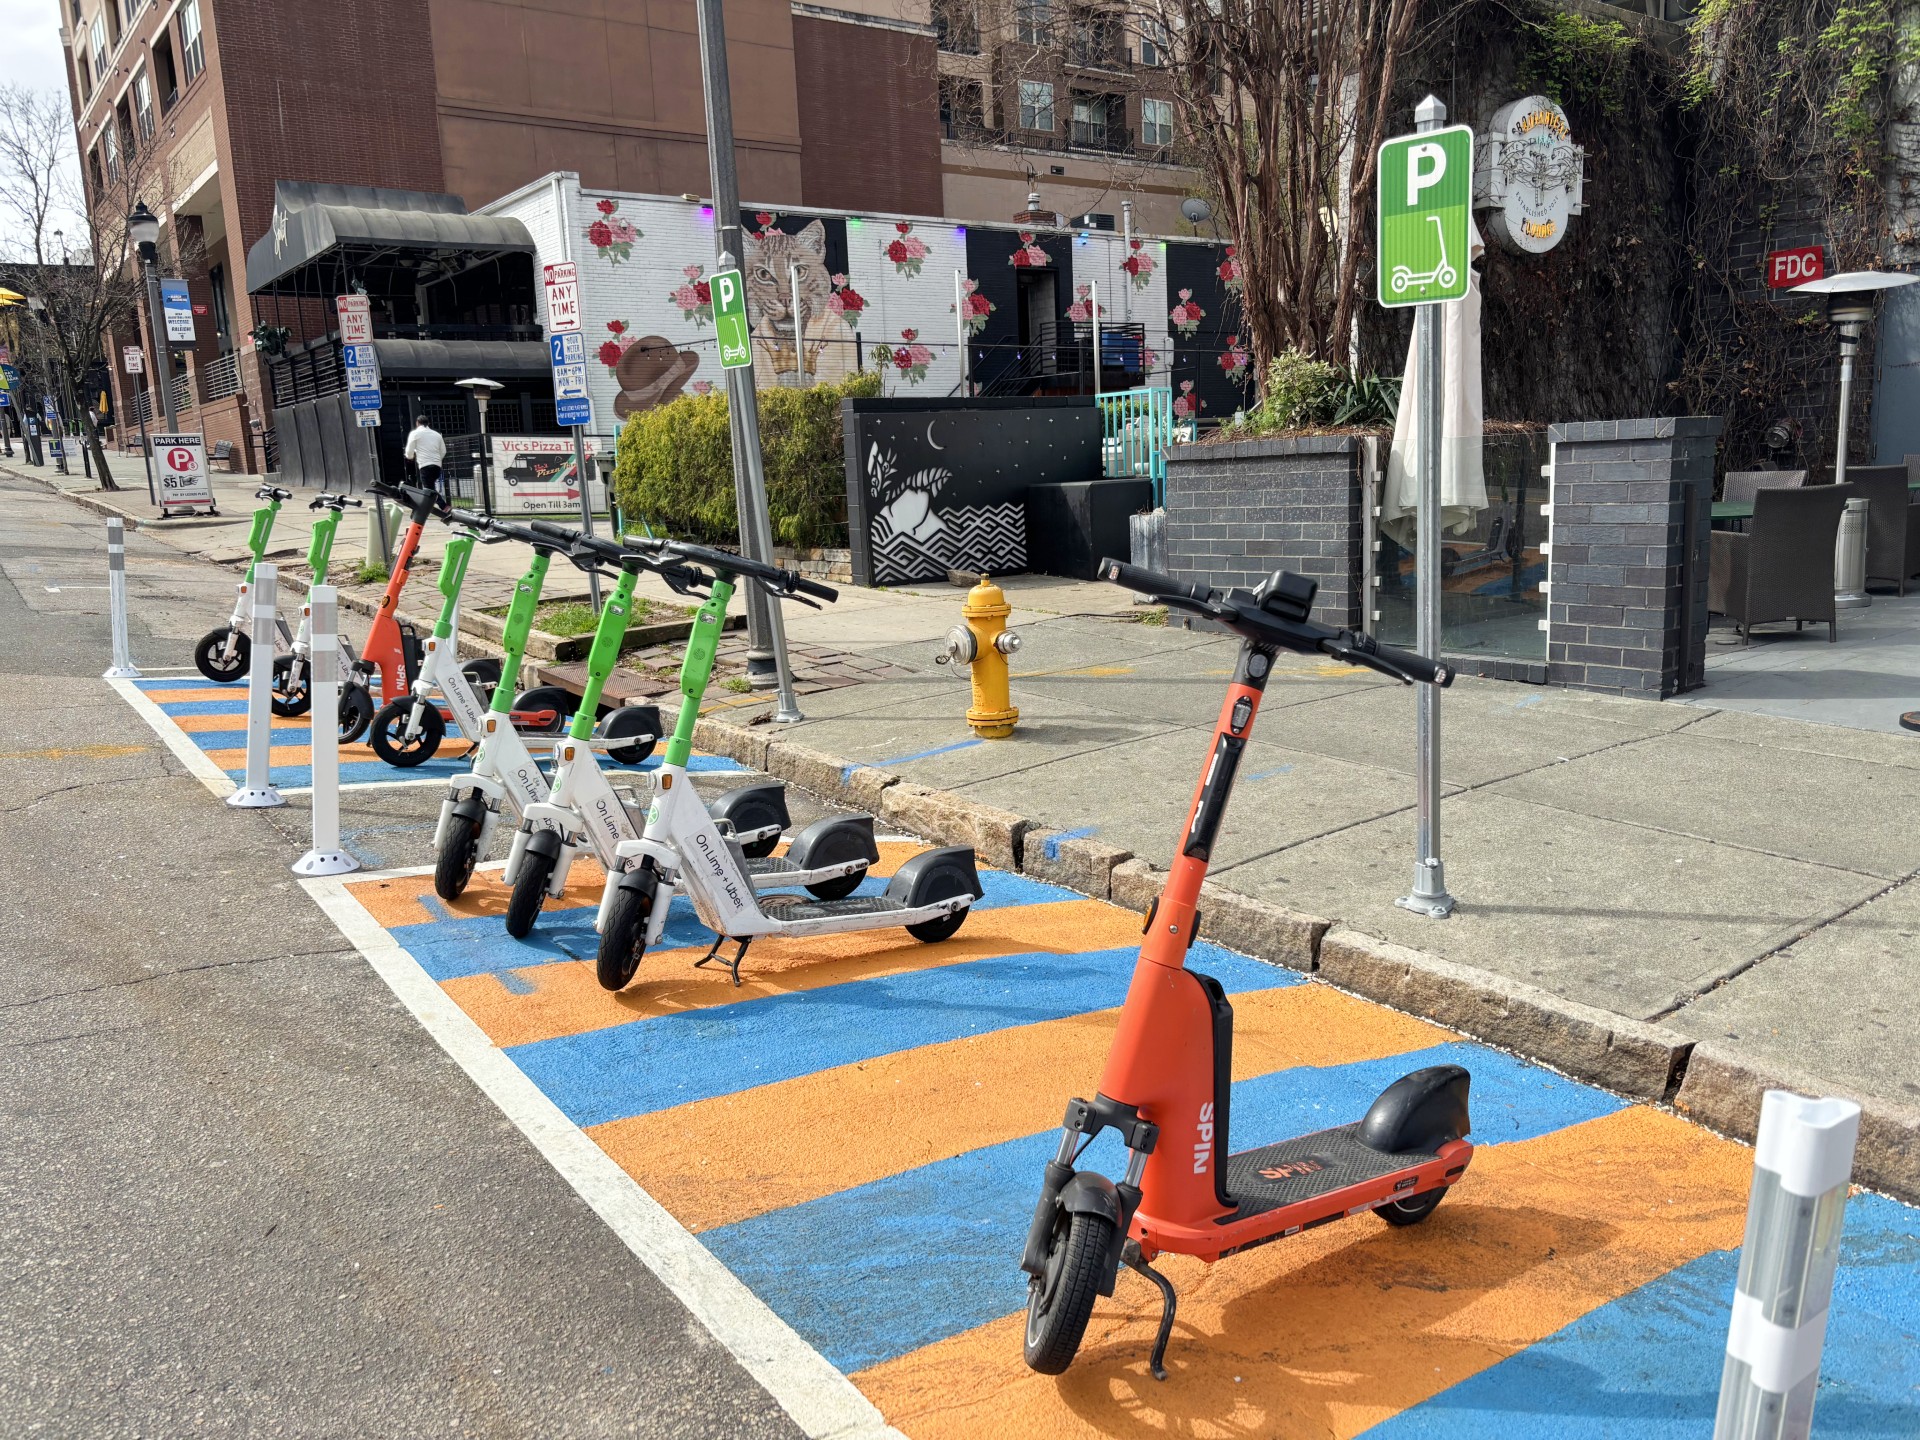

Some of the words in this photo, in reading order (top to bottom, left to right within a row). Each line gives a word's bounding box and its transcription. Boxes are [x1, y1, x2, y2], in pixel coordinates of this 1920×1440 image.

[1407, 143, 1447, 206] P
[1515, 191, 1548, 217] ESTABLISHED
[1775, 253, 1816, 280] FDC
[544, 269, 555, 282] NO
[555, 268, 576, 279] PARKING
[552, 285, 572, 301] ANY
[719, 277, 735, 312] P
[338, 299, 347, 310] NO
[551, 301, 576, 316] TIME
[347, 315, 363, 324] ANY
[346, 325, 366, 334] TIME
[347, 349, 355, 364] 2
[554, 340, 562, 360] 2
[565, 353, 584, 362] PARKING
[502, 441, 529, 451] Vic's
[532, 441, 561, 451] Pizza
[563, 441, 593, 451] Trk
[173, 450, 190, 469] P
[536, 467, 560, 478] Pizza
[164, 477, 177, 488] $5
[523, 501, 546, 510] Open
[396, 664, 406, 691] SPIN
[448, 677, 456, 689] On
[454, 687, 466, 704] Lime
[518, 769, 529, 784] On
[596, 800, 608, 817] On
[604, 815, 620, 840] Lime
[696, 834, 709, 852] On
[705, 850, 724, 876] Lime
[725, 882, 744, 908] Uber
[1194, 1102, 1214, 1174] SPIN
